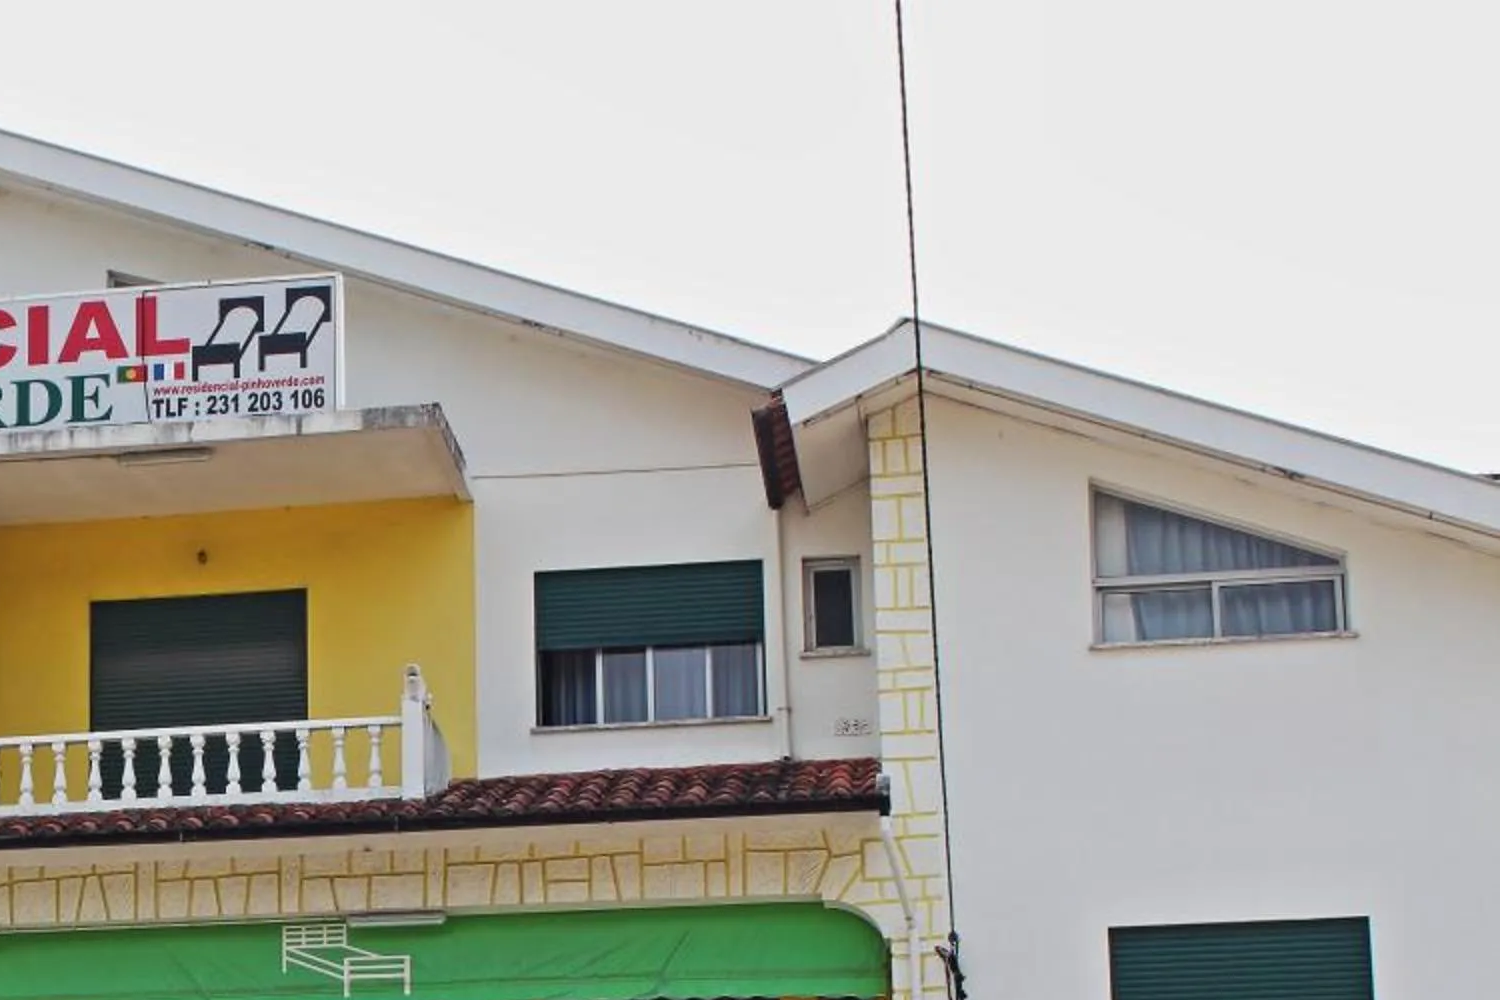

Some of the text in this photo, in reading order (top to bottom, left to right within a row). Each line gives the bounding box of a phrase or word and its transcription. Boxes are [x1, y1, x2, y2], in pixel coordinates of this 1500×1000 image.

[153, 375, 325, 397] www.residencial-pinhoverde.com
[206, 393, 239, 414] 231
[248, 391, 283, 412] 203
[290, 388, 325, 409] 106
